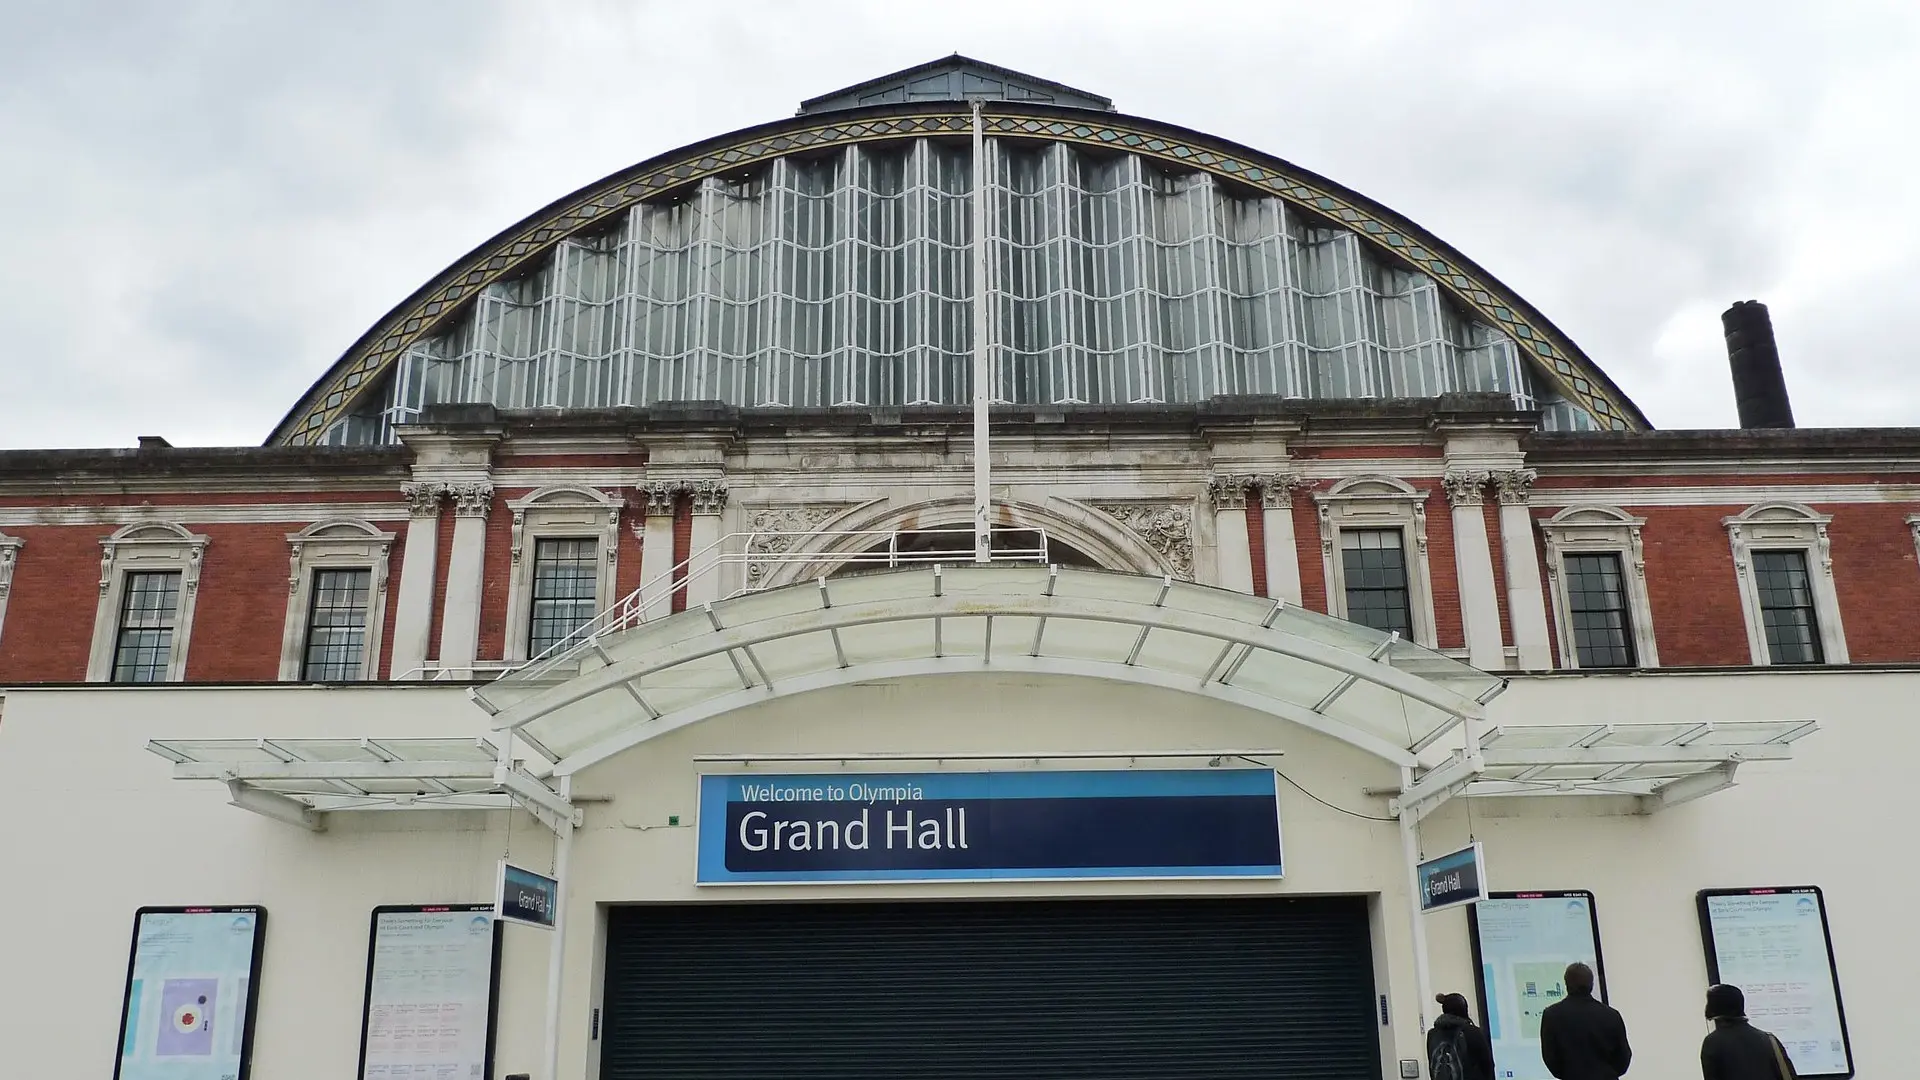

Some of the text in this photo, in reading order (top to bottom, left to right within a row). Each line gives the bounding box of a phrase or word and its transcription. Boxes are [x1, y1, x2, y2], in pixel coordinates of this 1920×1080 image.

[741, 783, 923, 805] Welcome to Olympia
[739, 807, 968, 851] Grand Hall
[1430, 871, 1461, 896] Grand Hall
[518, 890, 546, 913] Grand Hall
